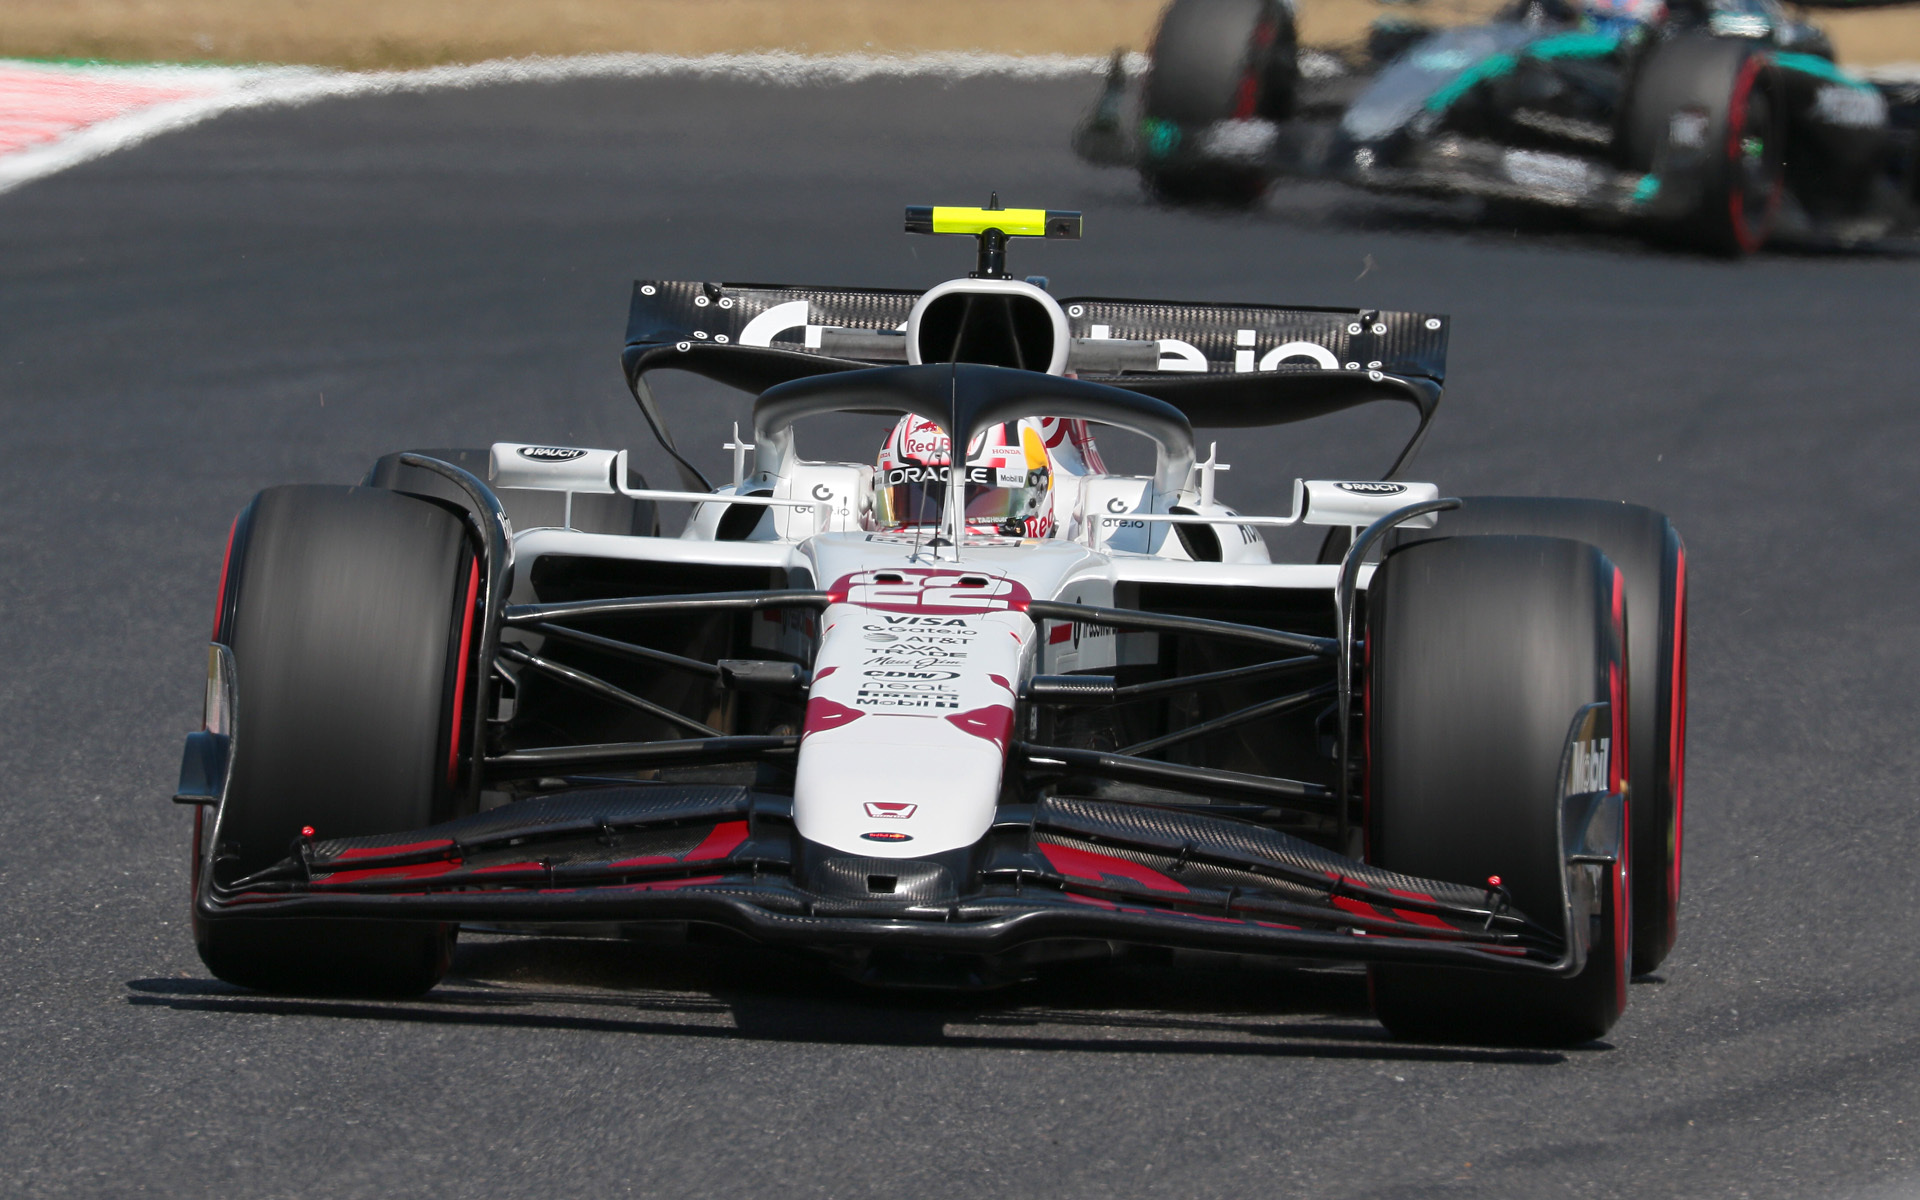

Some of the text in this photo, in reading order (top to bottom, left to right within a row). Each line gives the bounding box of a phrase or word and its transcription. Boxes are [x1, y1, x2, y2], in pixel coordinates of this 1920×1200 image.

[906, 436, 937, 454] Red
[533, 447, 579, 457] RAUCH
[888, 466, 988, 485] ORACE
[1000, 474, 1017, 483] Mobil
[1353, 483, 1399, 491] RAUCH
[847, 573, 1013, 610] 22
[883, 615, 967, 627] VISA
[888, 626, 978, 635] Gate.io
[905, 635, 974, 645] AT&T
[865, 648, 968, 658] TRADE
[862, 656, 913, 666] Maui
[863, 670, 938, 679] CDW
[856, 698, 929, 707] Mobil
[1571, 737, 1609, 795] Mobil
